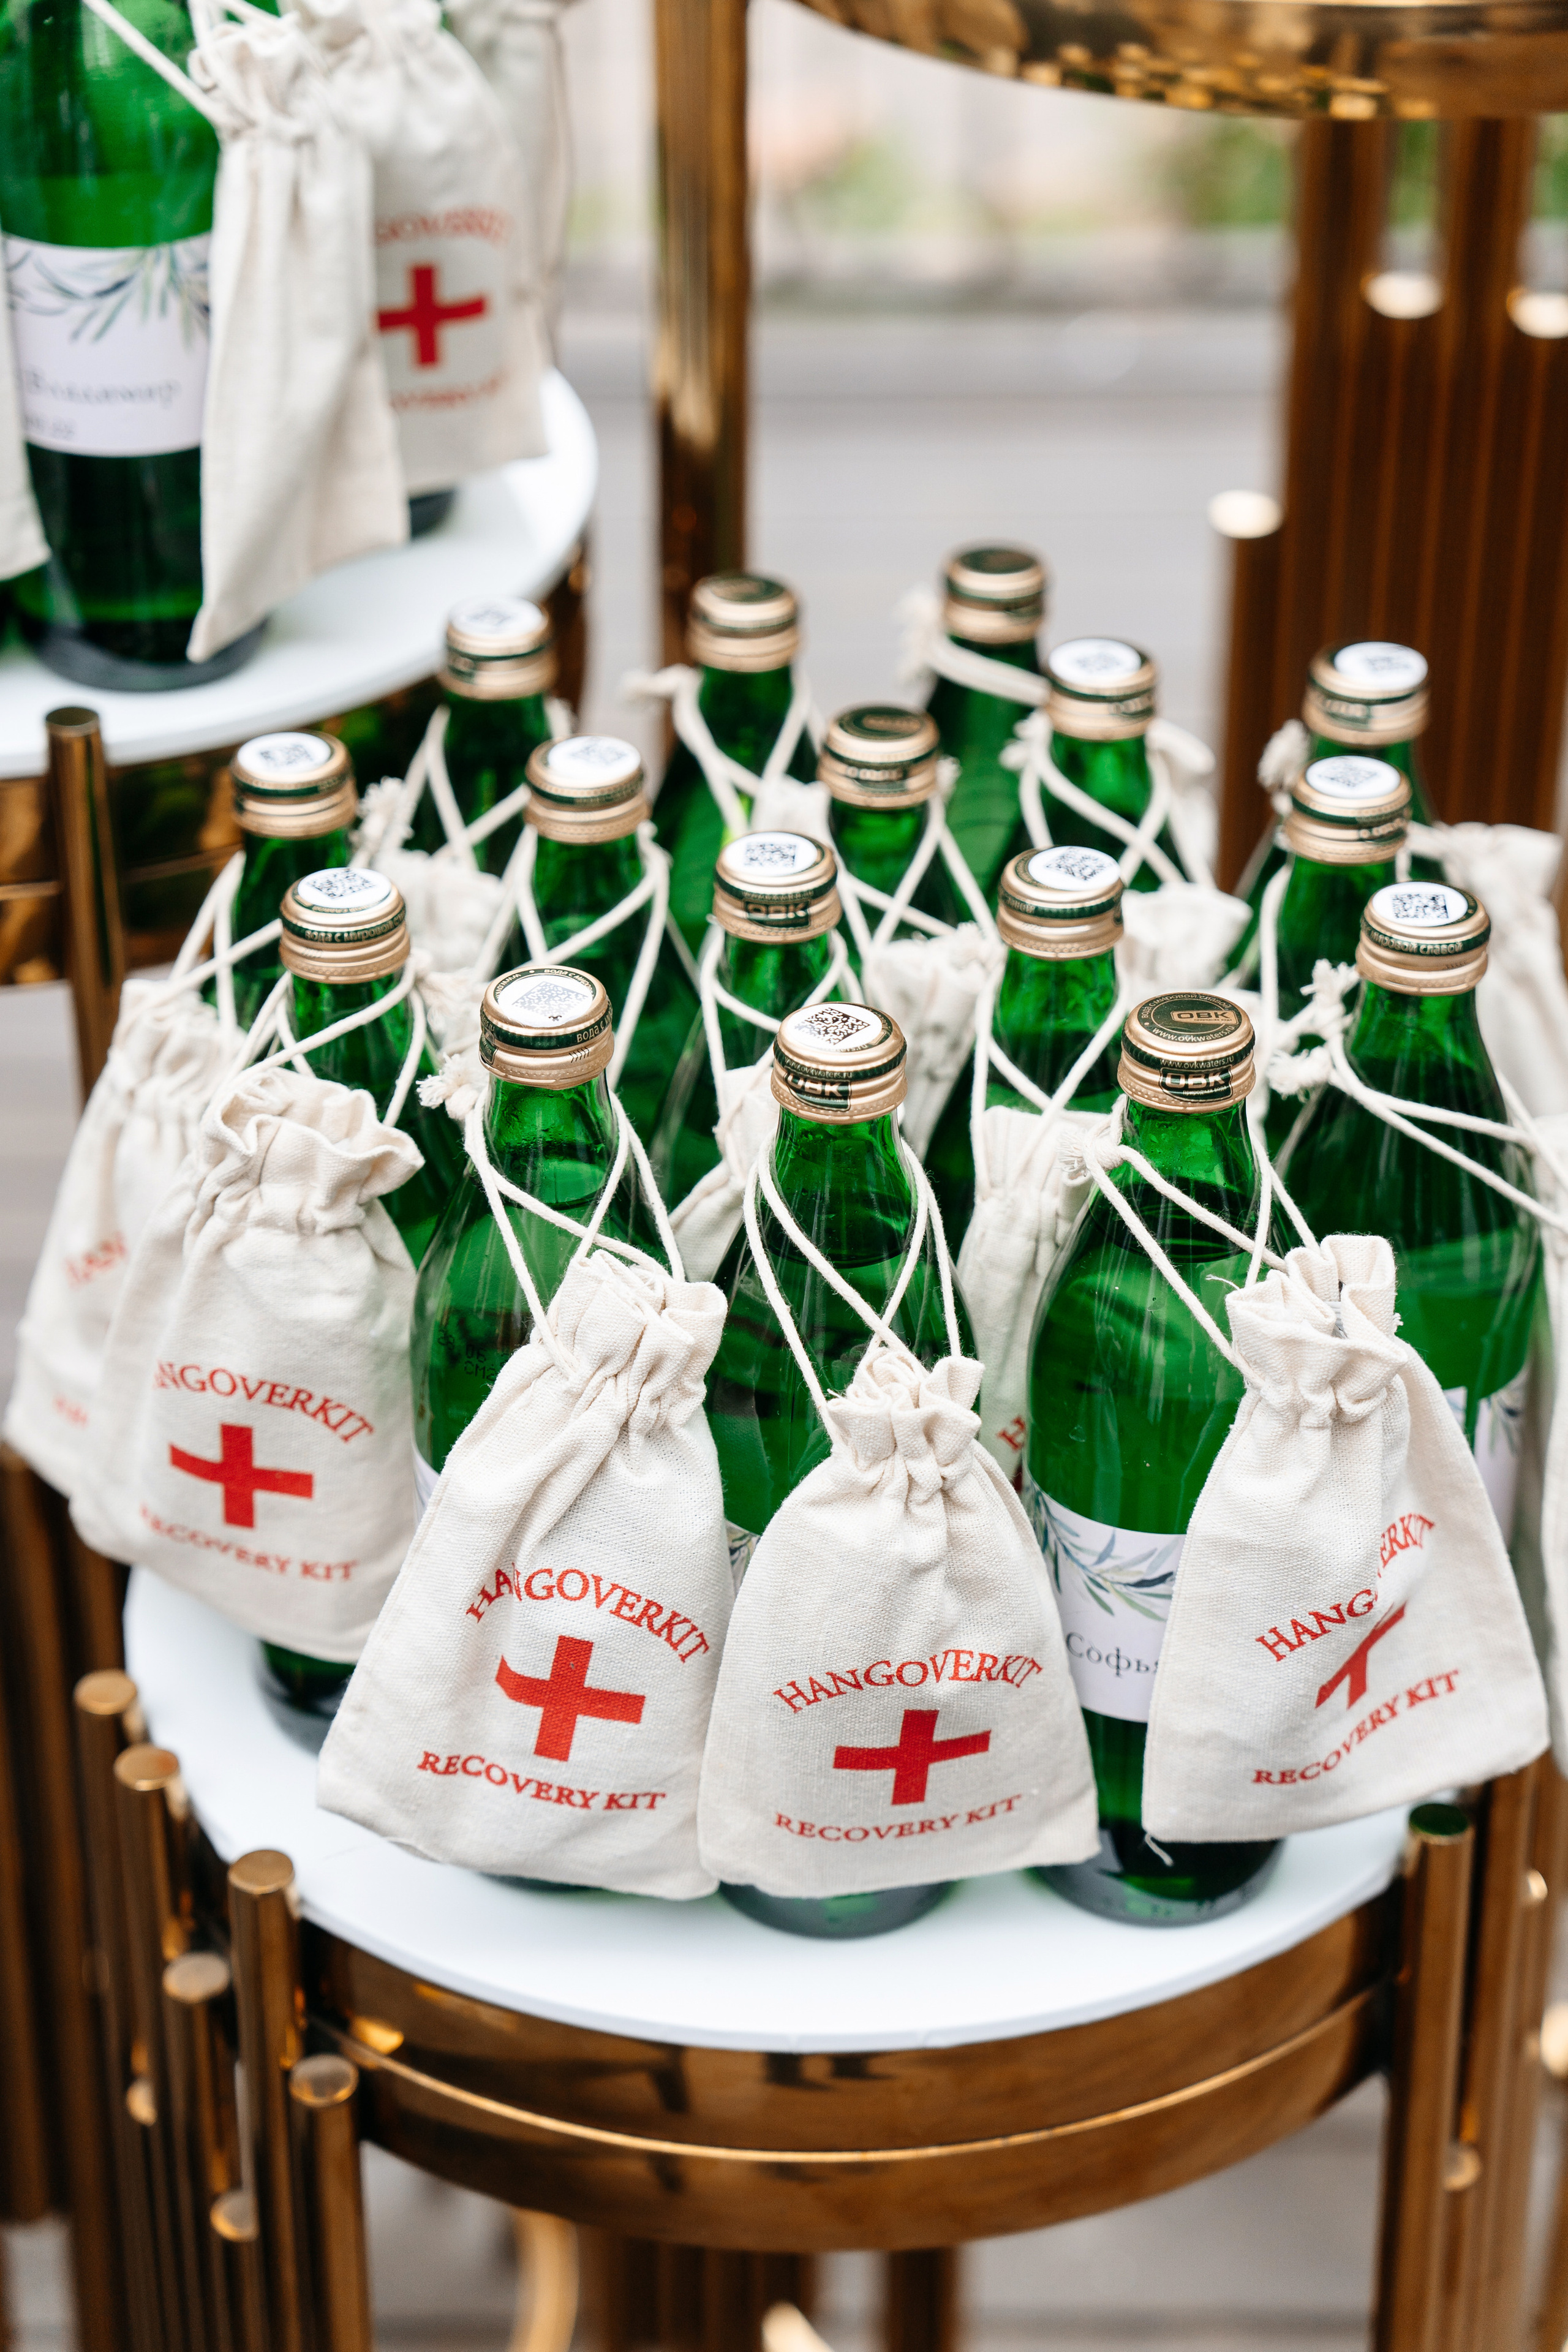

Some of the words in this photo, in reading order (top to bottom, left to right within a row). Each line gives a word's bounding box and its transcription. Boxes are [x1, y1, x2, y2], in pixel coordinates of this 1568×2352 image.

[576, 1025, 600, 1043] вода
[1152, 1025, 1235, 1042] www.ovkwaters.ru
[1159, 1055, 1235, 1069] www.ovkwaters.ru
[156, 1361, 375, 1444] NGOVERKIT
[300, 1559, 358, 1582] KIT
[772, 1649, 1044, 1714] HANGOVERKIT
[1253, 1695, 1399, 1785] RECOVERY
[1405, 1668, 1459, 1709] KIT
[417, 1751, 600, 1810] RECOVERY
[603, 1792, 667, 1811] KIT
[774, 1812, 959, 1842] RECOVERY
[965, 1794, 1022, 1825] KIT
